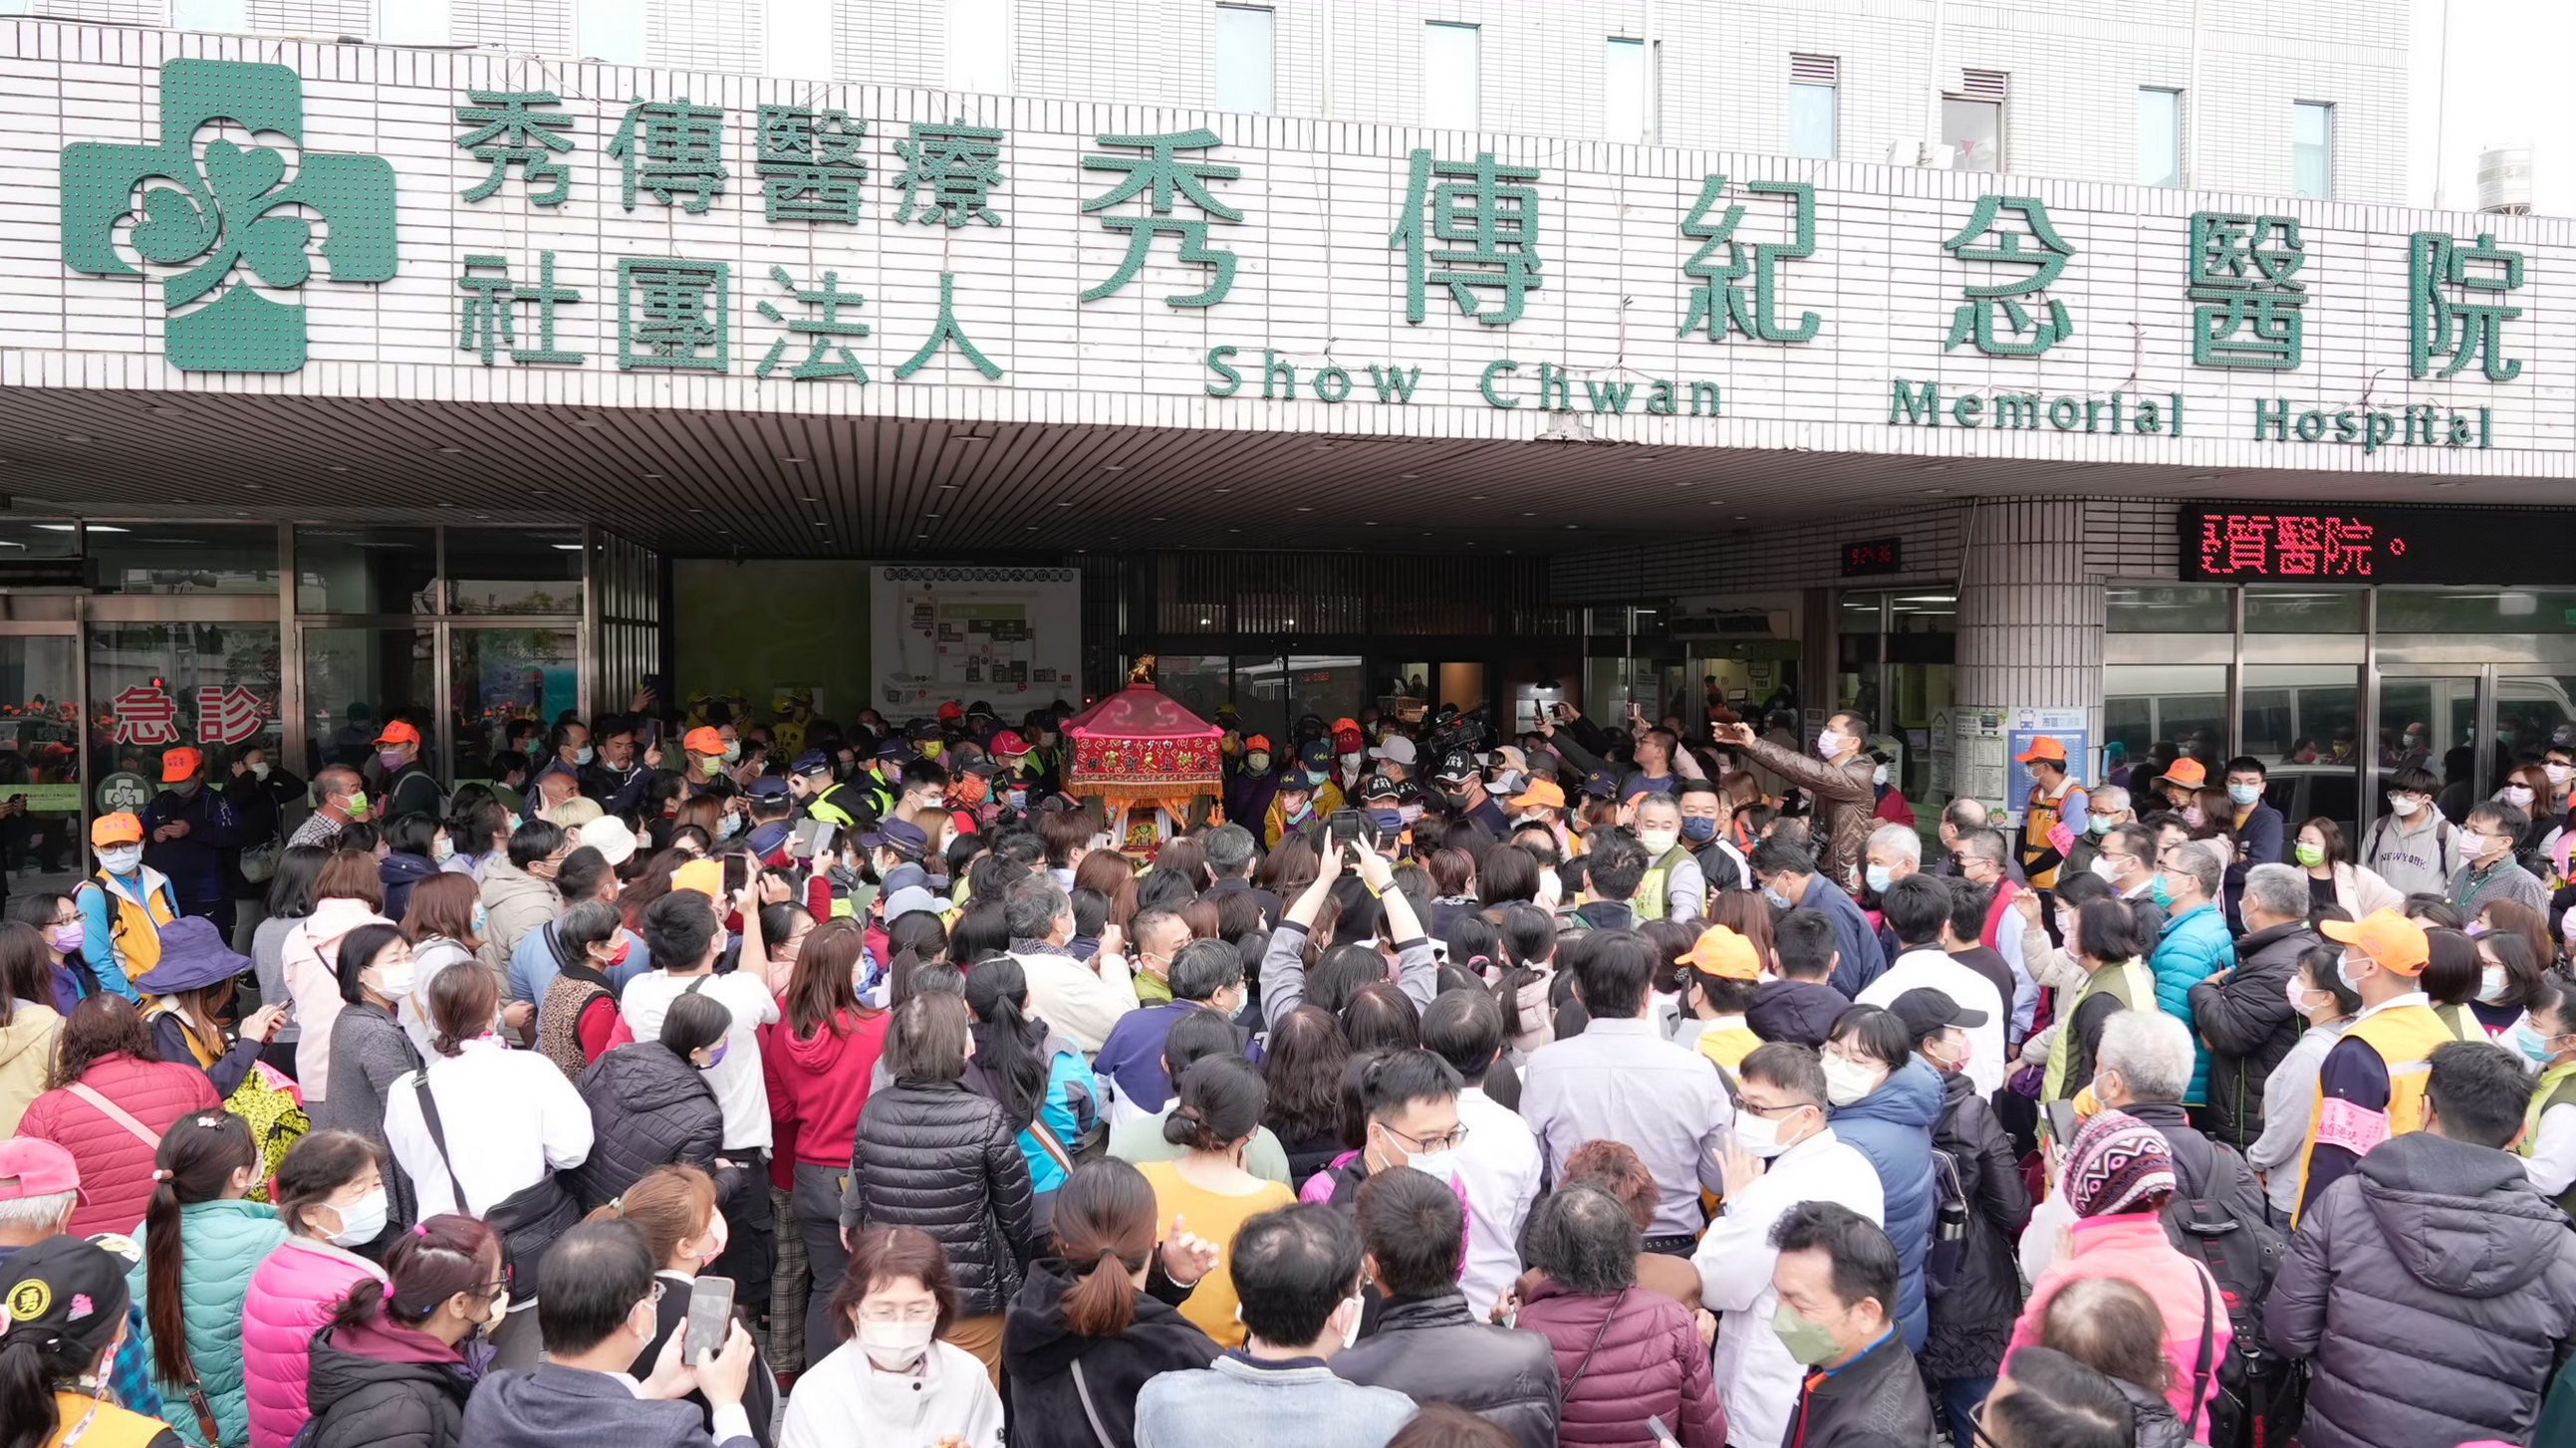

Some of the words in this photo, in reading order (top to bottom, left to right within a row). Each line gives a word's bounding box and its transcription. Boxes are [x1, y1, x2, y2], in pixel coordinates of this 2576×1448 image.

[455, 89, 1003, 227] 秀傳醫療
[1079, 127, 2525, 382] 秀傳紀念醫院
[456, 250, 1003, 385] 社團法人
[1206, 344, 1422, 404] Show
[1480, 359, 1722, 417] Chwan
[1890, 377, 2184, 437] Memorial
[2254, 397, 2493, 456] Hospital
[115, 684, 262, 745] 急診
[19, 1288, 40, 1314] 勇
